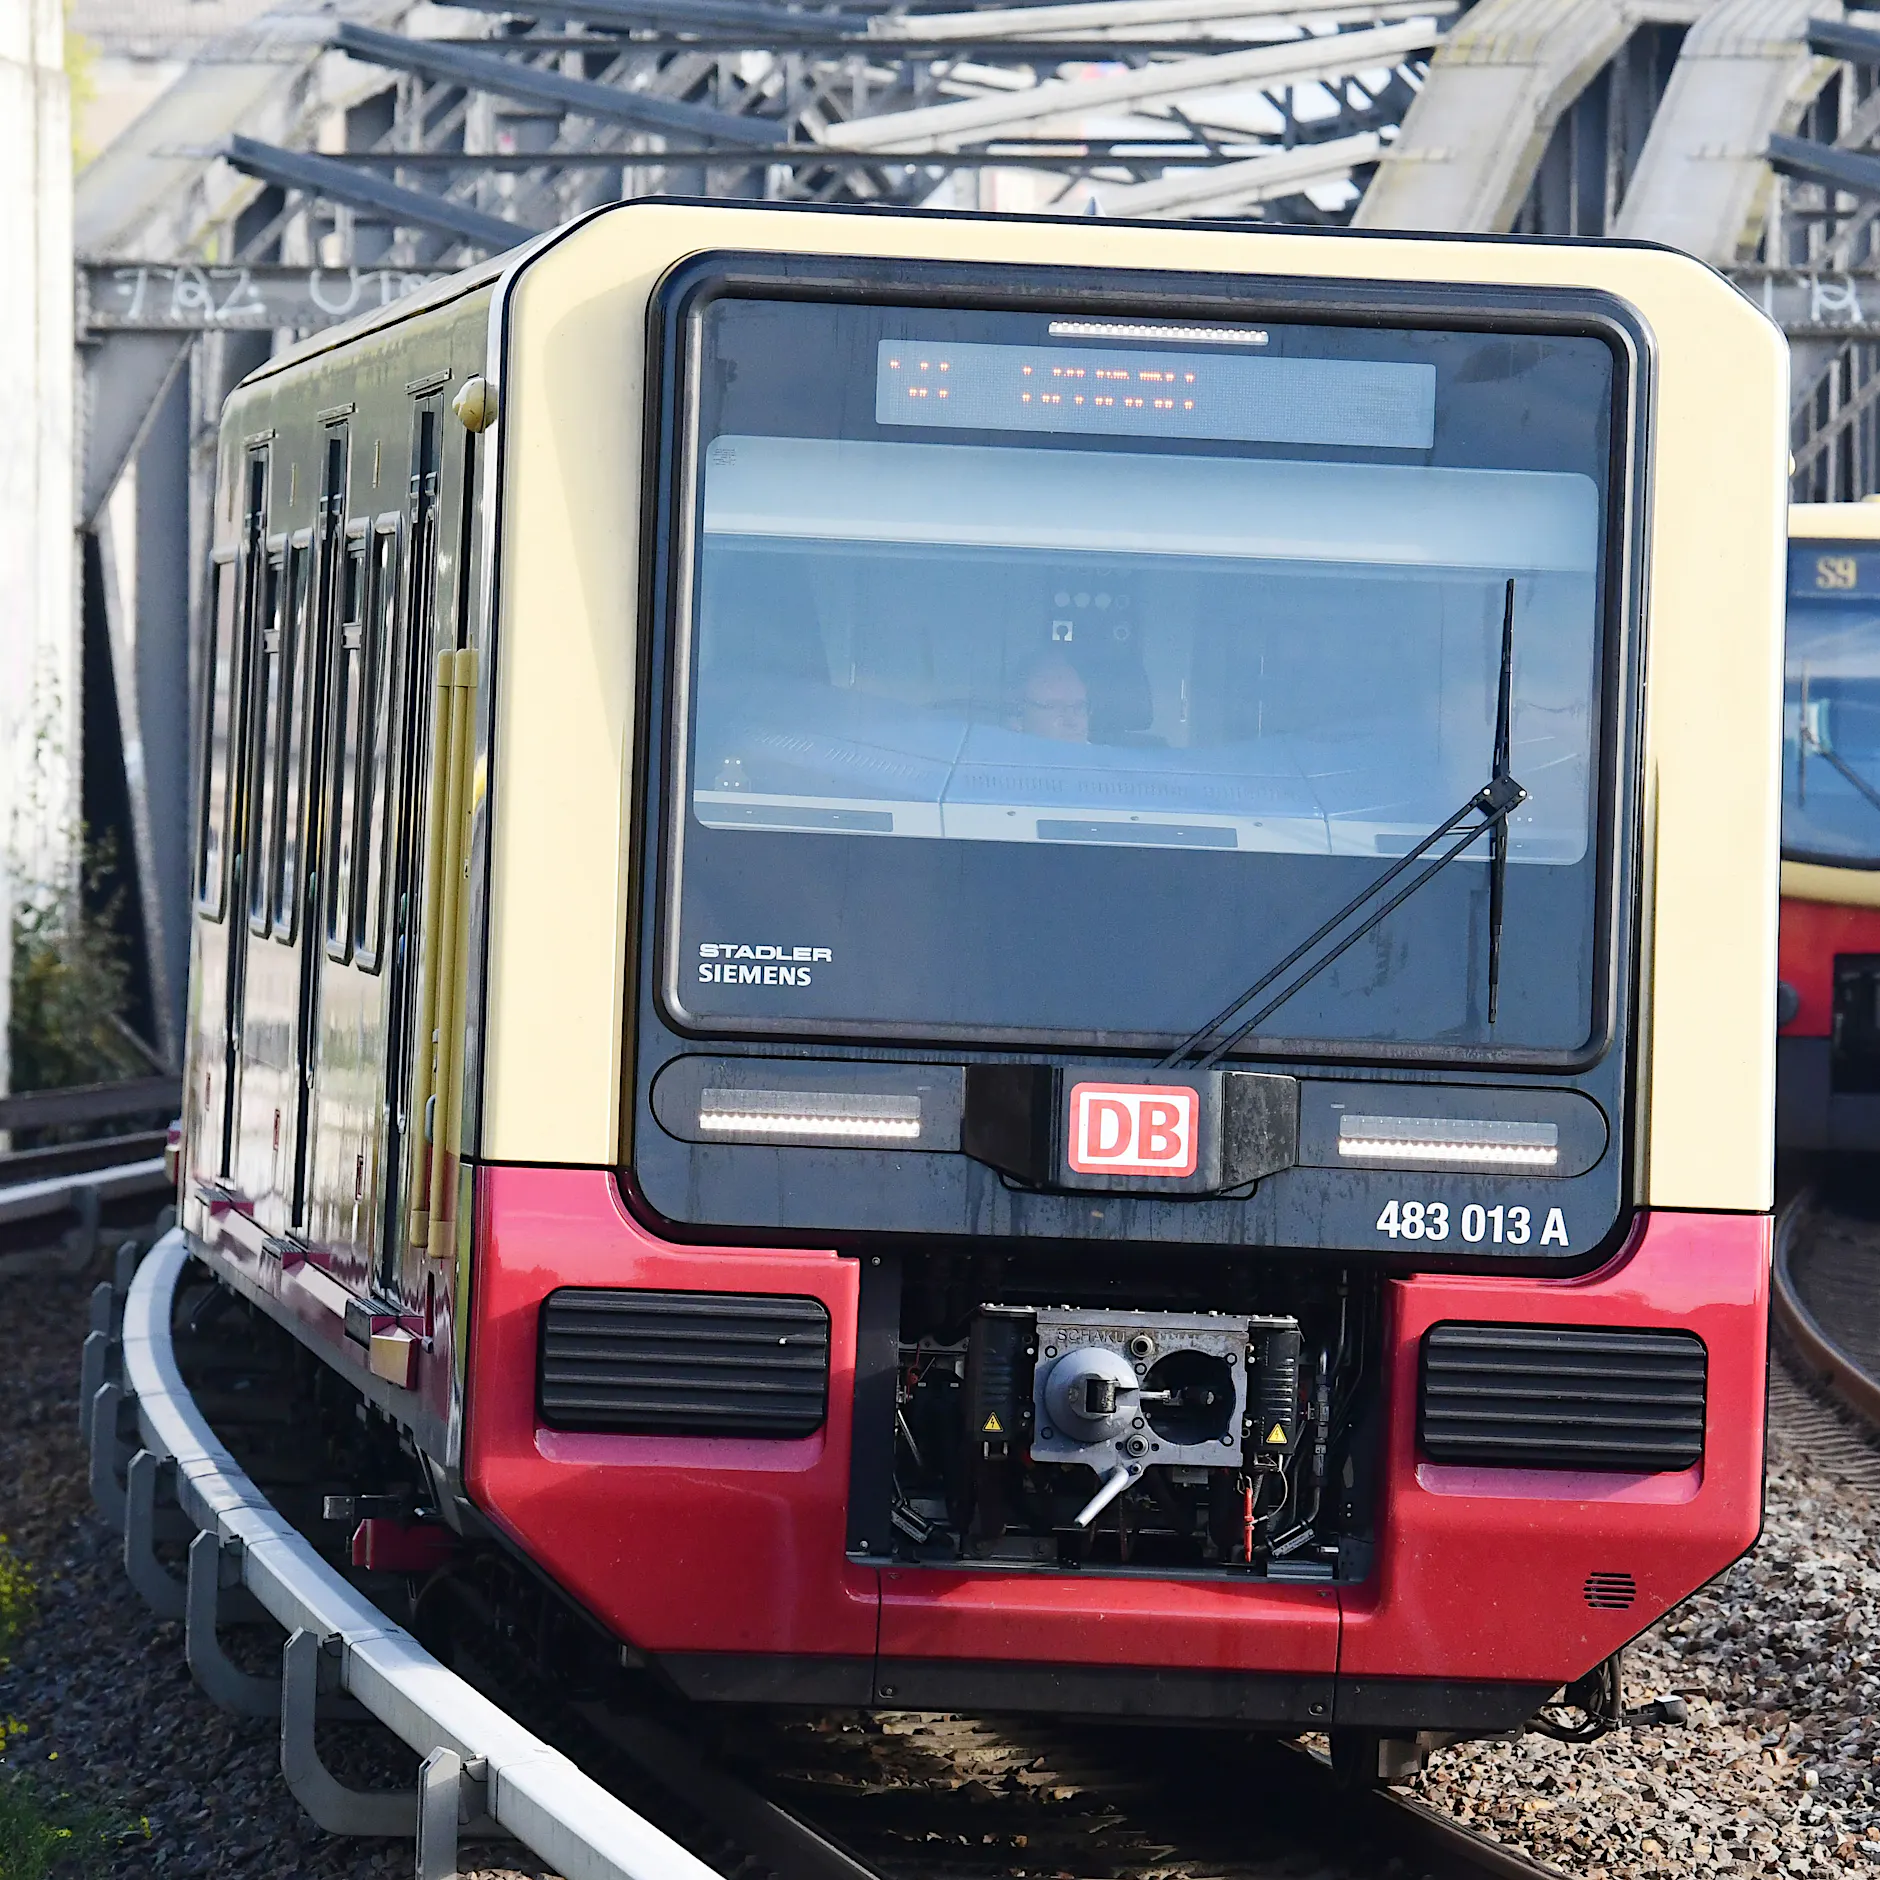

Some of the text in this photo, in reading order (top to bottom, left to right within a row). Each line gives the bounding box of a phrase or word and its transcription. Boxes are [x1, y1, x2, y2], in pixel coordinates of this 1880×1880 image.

[1816, 557, 1857, 589] S9
[699, 943, 832, 962] STADLER
[698, 963, 812, 987] SIEMENS
[1087, 1098, 1182, 1160] DB
[1376, 1200, 1569, 1247] 483 013 A
[1057, 1328, 1126, 1344] SCHAKU
